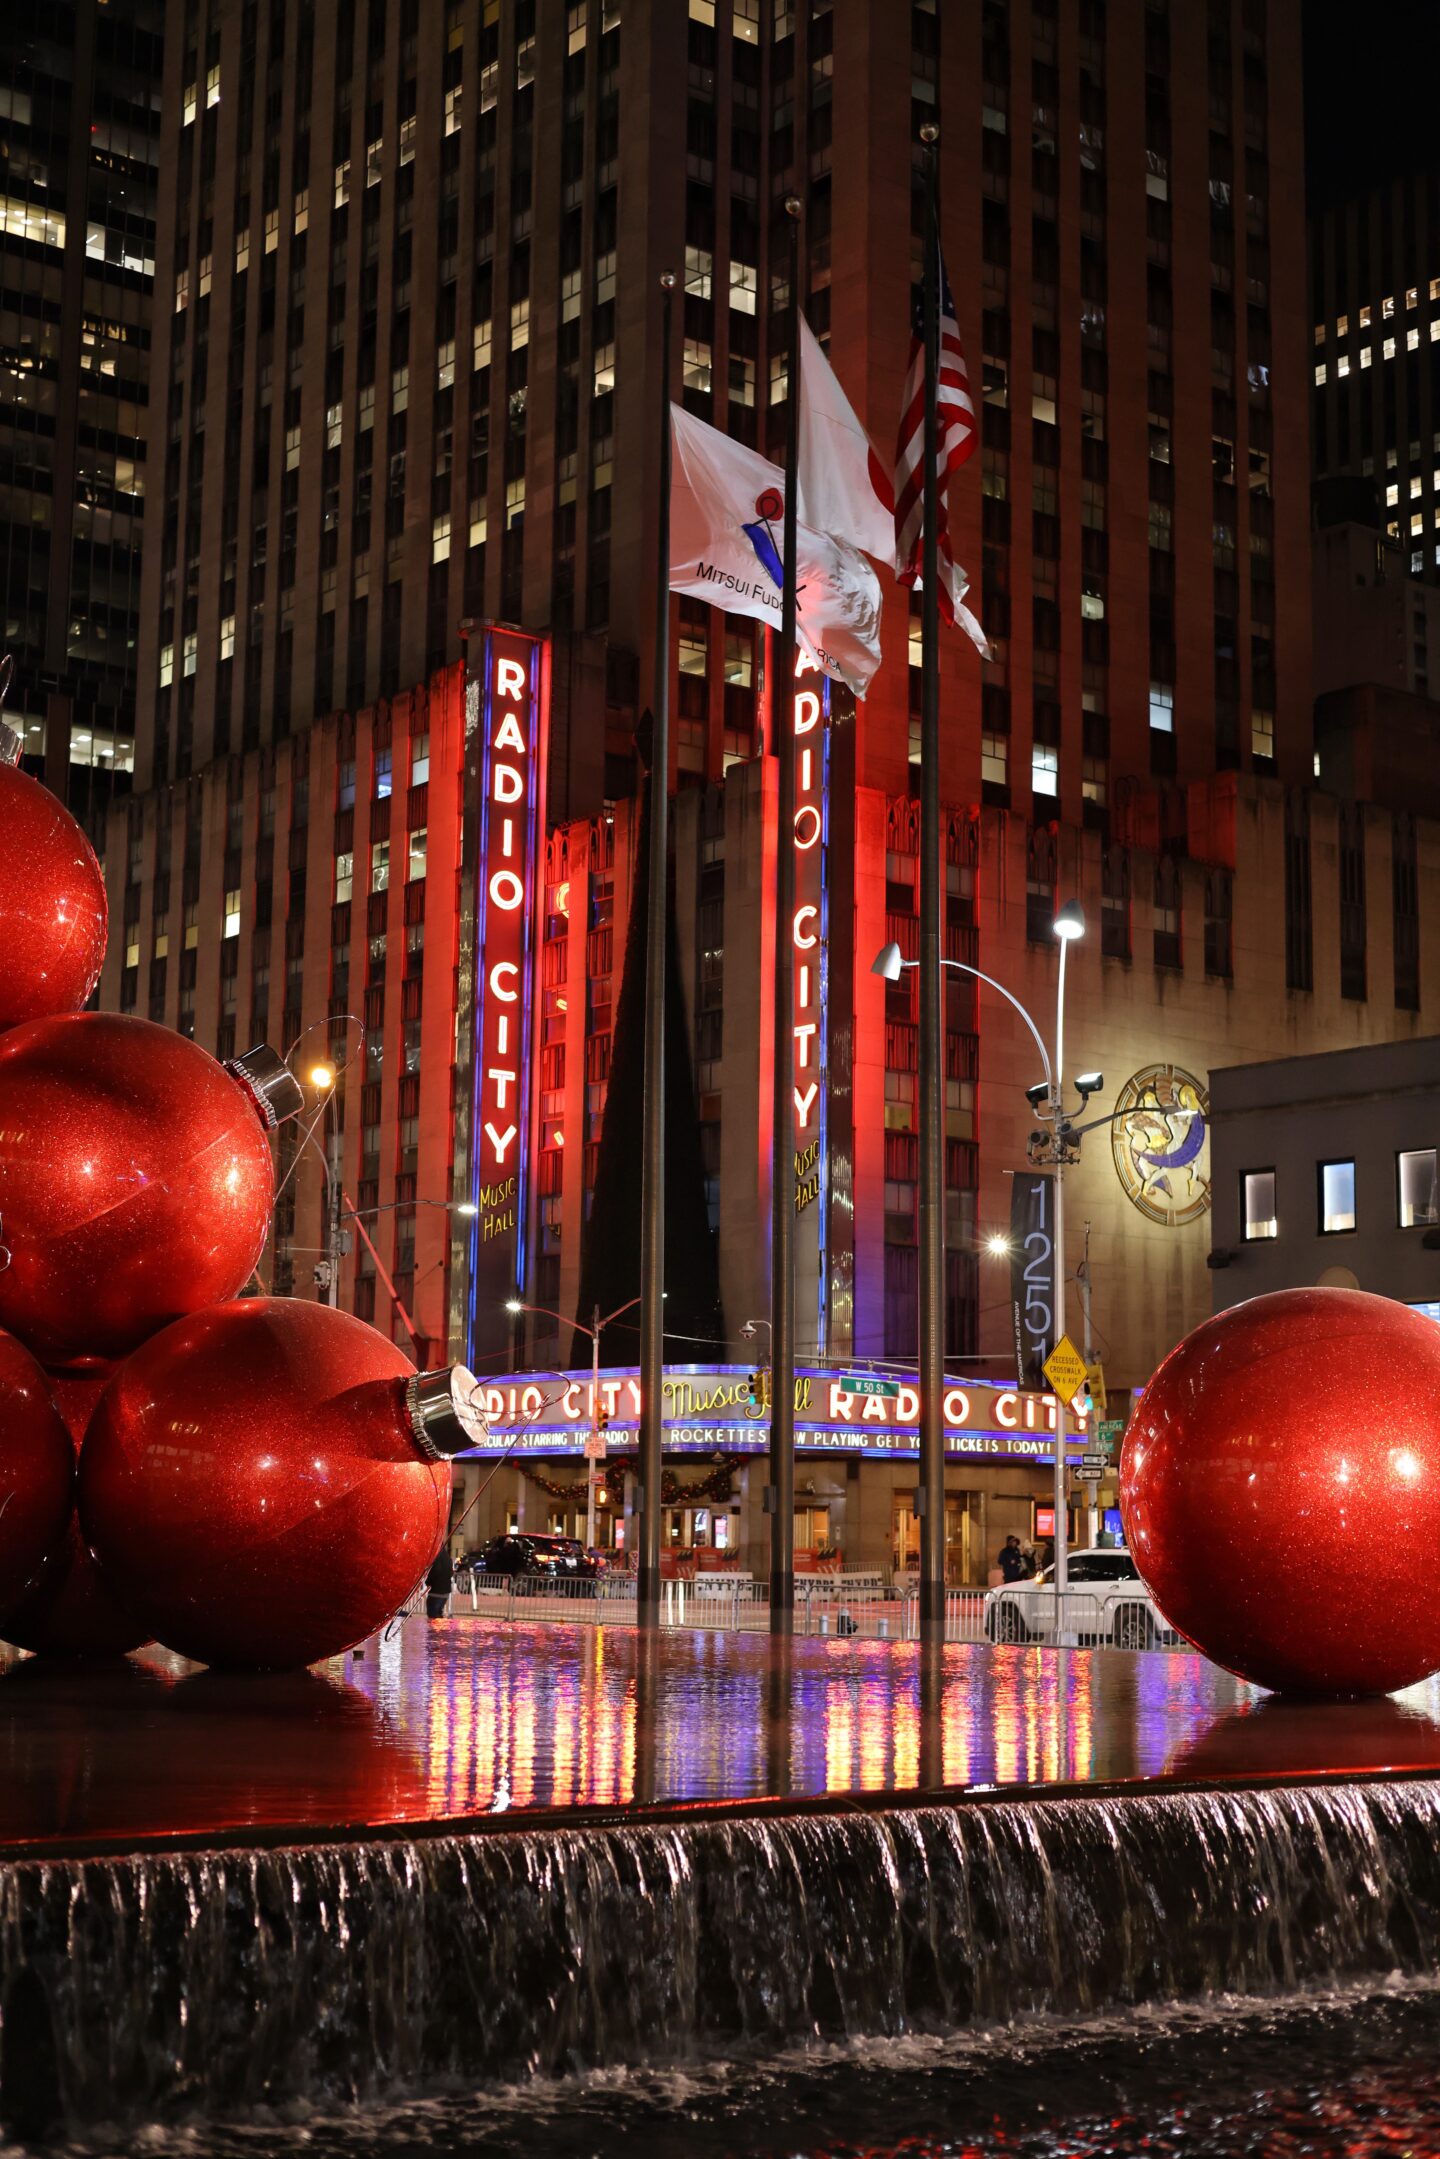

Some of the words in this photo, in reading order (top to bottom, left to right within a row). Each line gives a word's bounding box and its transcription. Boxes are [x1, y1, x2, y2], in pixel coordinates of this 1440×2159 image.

[696, 561, 750, 596] MITSUI
[489, 657, 526, 913] RADIO
[793, 905, 820, 1130] CITY
[483, 961, 519, 1165] CITY
[480, 1177, 516, 1214] MUSIC
[483, 1209, 515, 1242] HALL
[1023, 1180, 1051, 1388] 1251
[1049, 1365, 1082, 1376] CROSSWALK
[1051, 1355, 1079, 1366] RECESSED
[855, 1382, 862, 1392] W
[863, 1382, 874, 1393] 50
[875, 1383, 885, 1394] St
[1053, 1376, 1061, 1384] ON
[1067, 1377, 1078, 1385] AVE
[662, 1381, 750, 1418] Music
[829, 1384, 970, 1425] RADO
[522, 1432, 568, 1447] STARRING
[670, 1429, 767, 1443] ROCKETTES
[813, 1432, 869, 1447] PLAYING
[876, 1435, 901, 1448] GET
[949, 1438, 999, 1453] TICKETS
[1007, 1440, 1051, 1455] TODAY!
